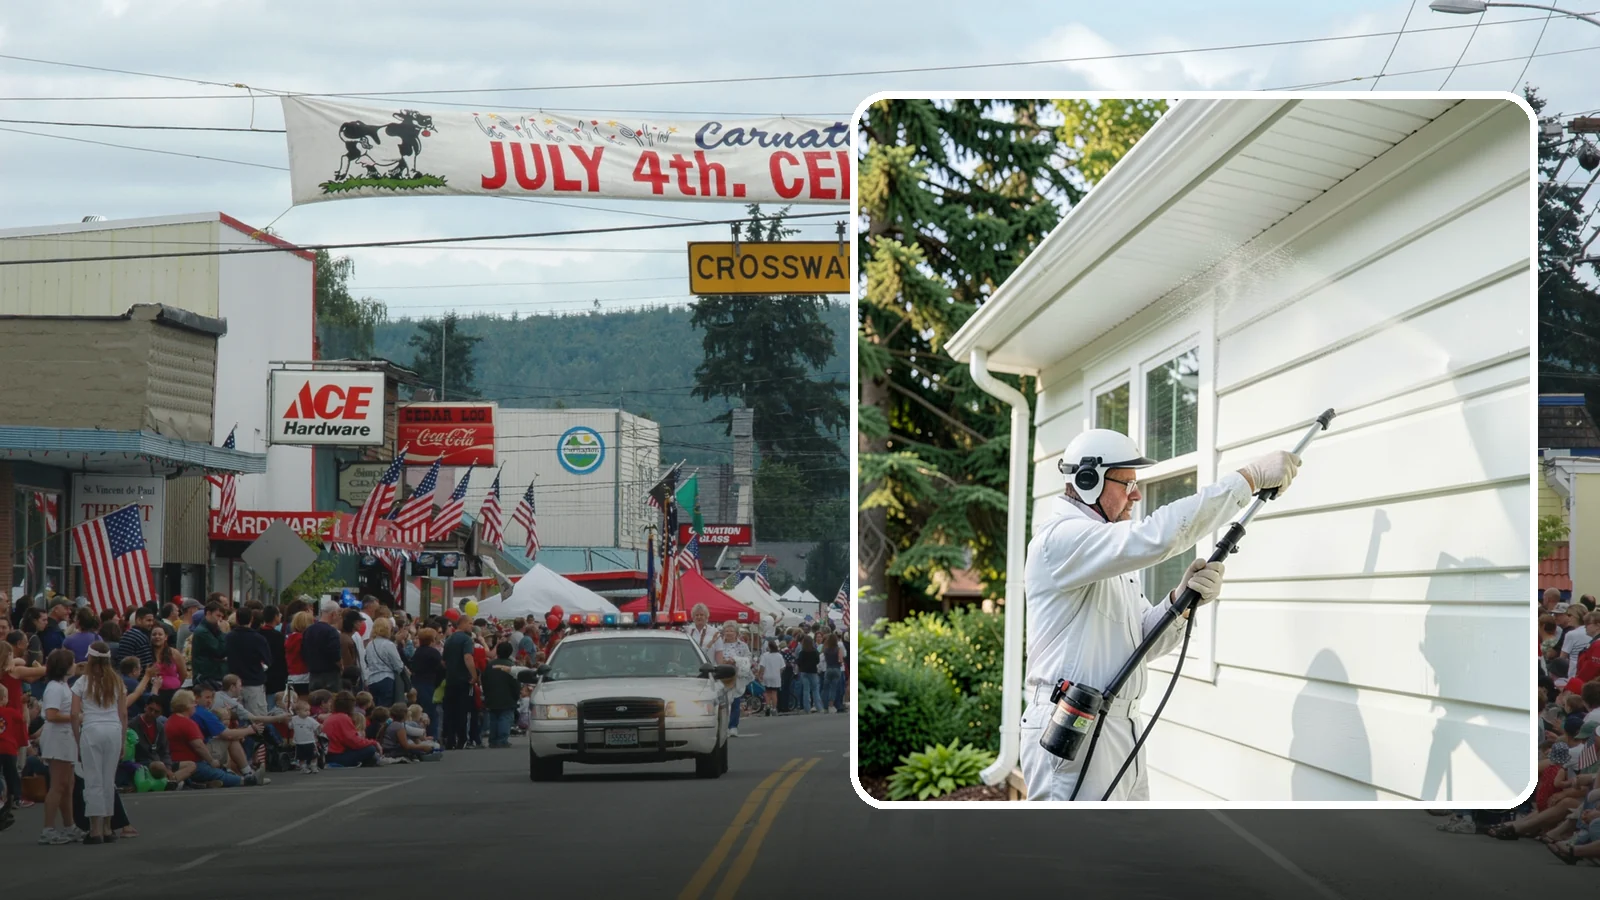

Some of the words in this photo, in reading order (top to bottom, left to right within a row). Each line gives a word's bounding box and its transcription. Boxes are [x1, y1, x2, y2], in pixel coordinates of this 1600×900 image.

[481, 141, 605, 193] JULY
[632, 150, 746, 197] 4th.
[697, 253, 850, 280] CROSSWA
[283, 380, 374, 419] ACE
[406, 410, 452, 421] CEDAR
[283, 421, 371, 437] Hardware
[96, 485, 124, 494] Vincent
[126, 485, 135, 494] de
[137, 486, 155, 495] Paul
[688, 526, 741, 535] CRNATION
[699, 535, 730, 543] GLASS
